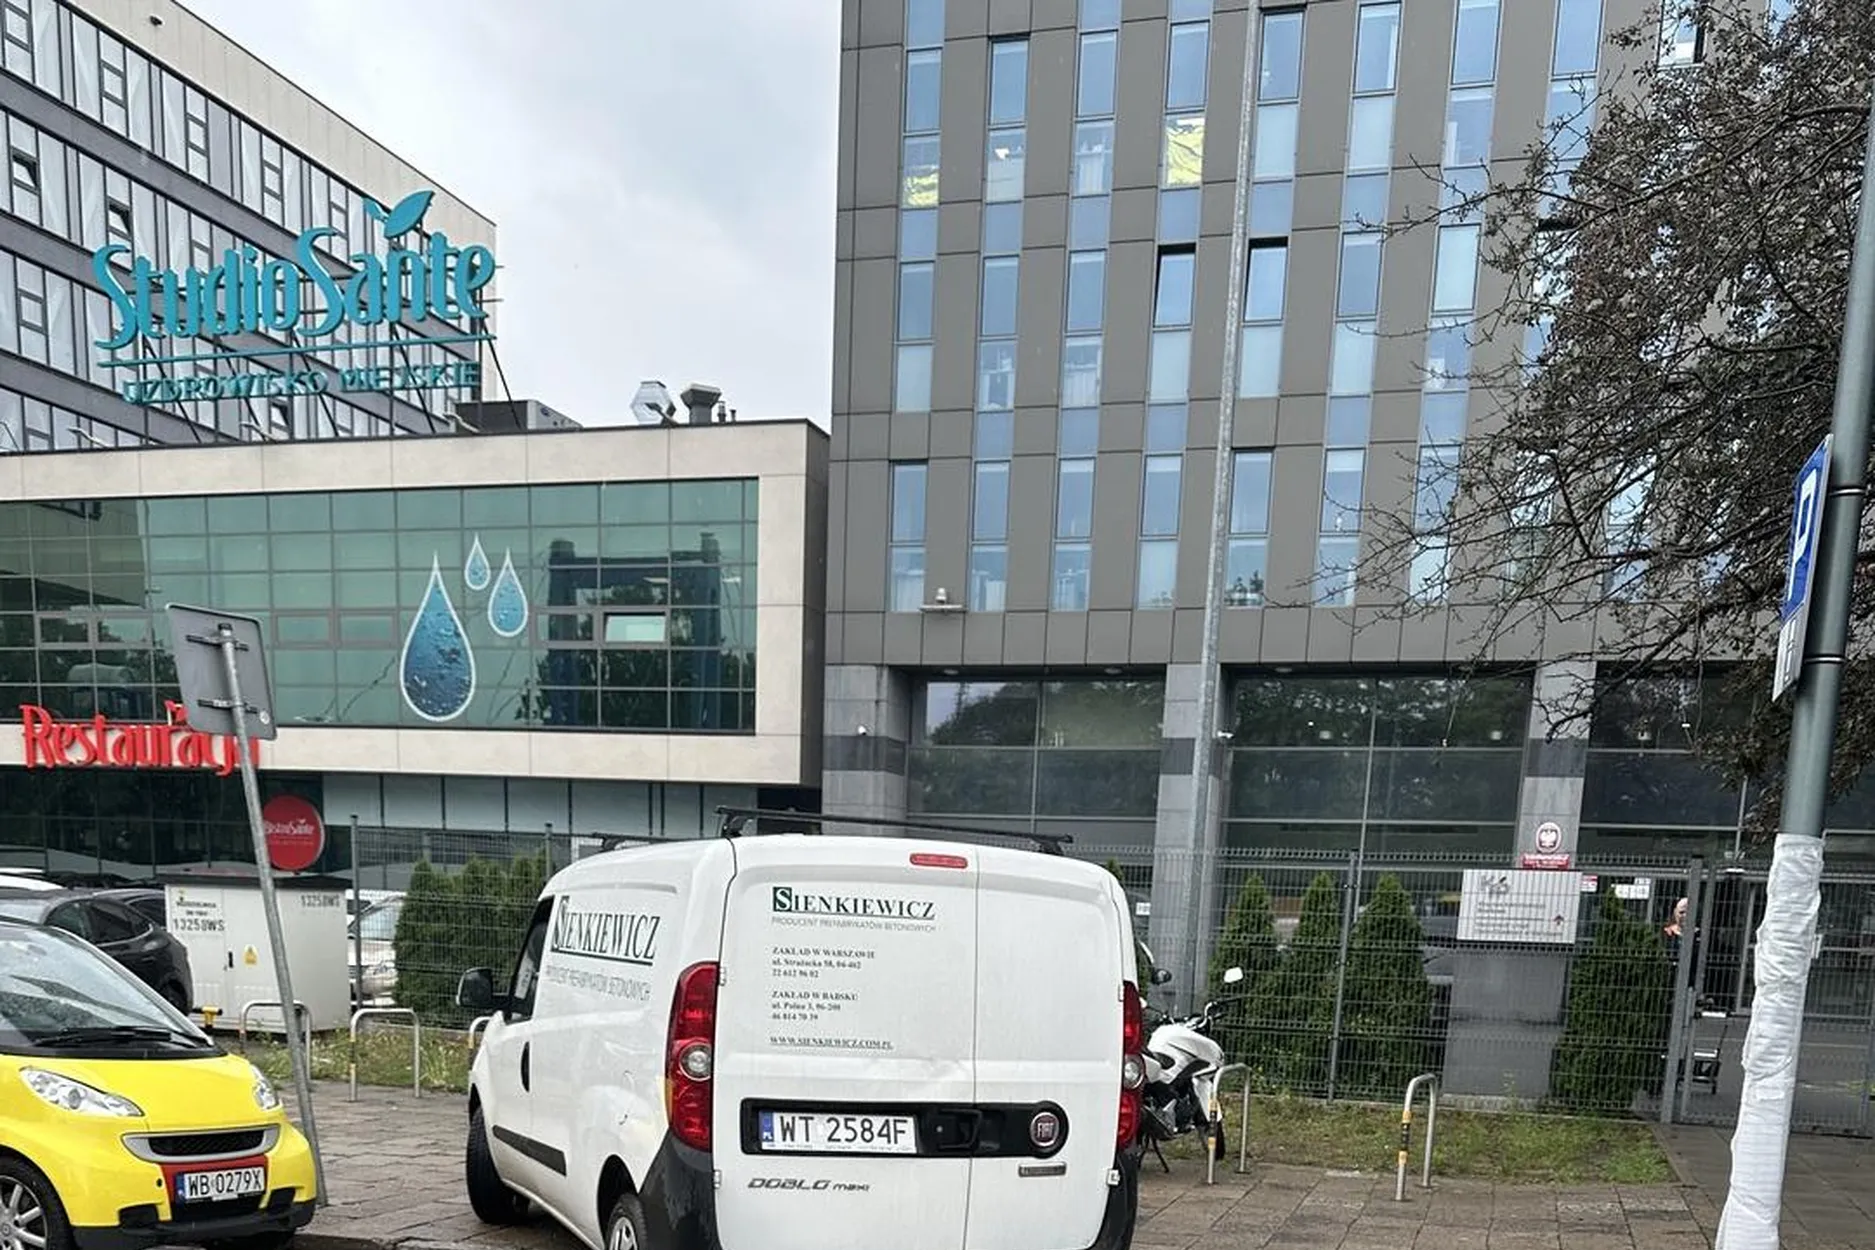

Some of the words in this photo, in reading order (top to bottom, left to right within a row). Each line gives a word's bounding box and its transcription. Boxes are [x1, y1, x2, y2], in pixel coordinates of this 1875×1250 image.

[772, 886, 935, 919] SIENKIEWICZ
[550, 895, 661, 960] SIENKIEWICZ
[779, 1115, 815, 1143] WT
[826, 1116, 909, 1145] 2584F
[188, 1174, 211, 1196] WB
[215, 1169, 262, 1194] 0279X
